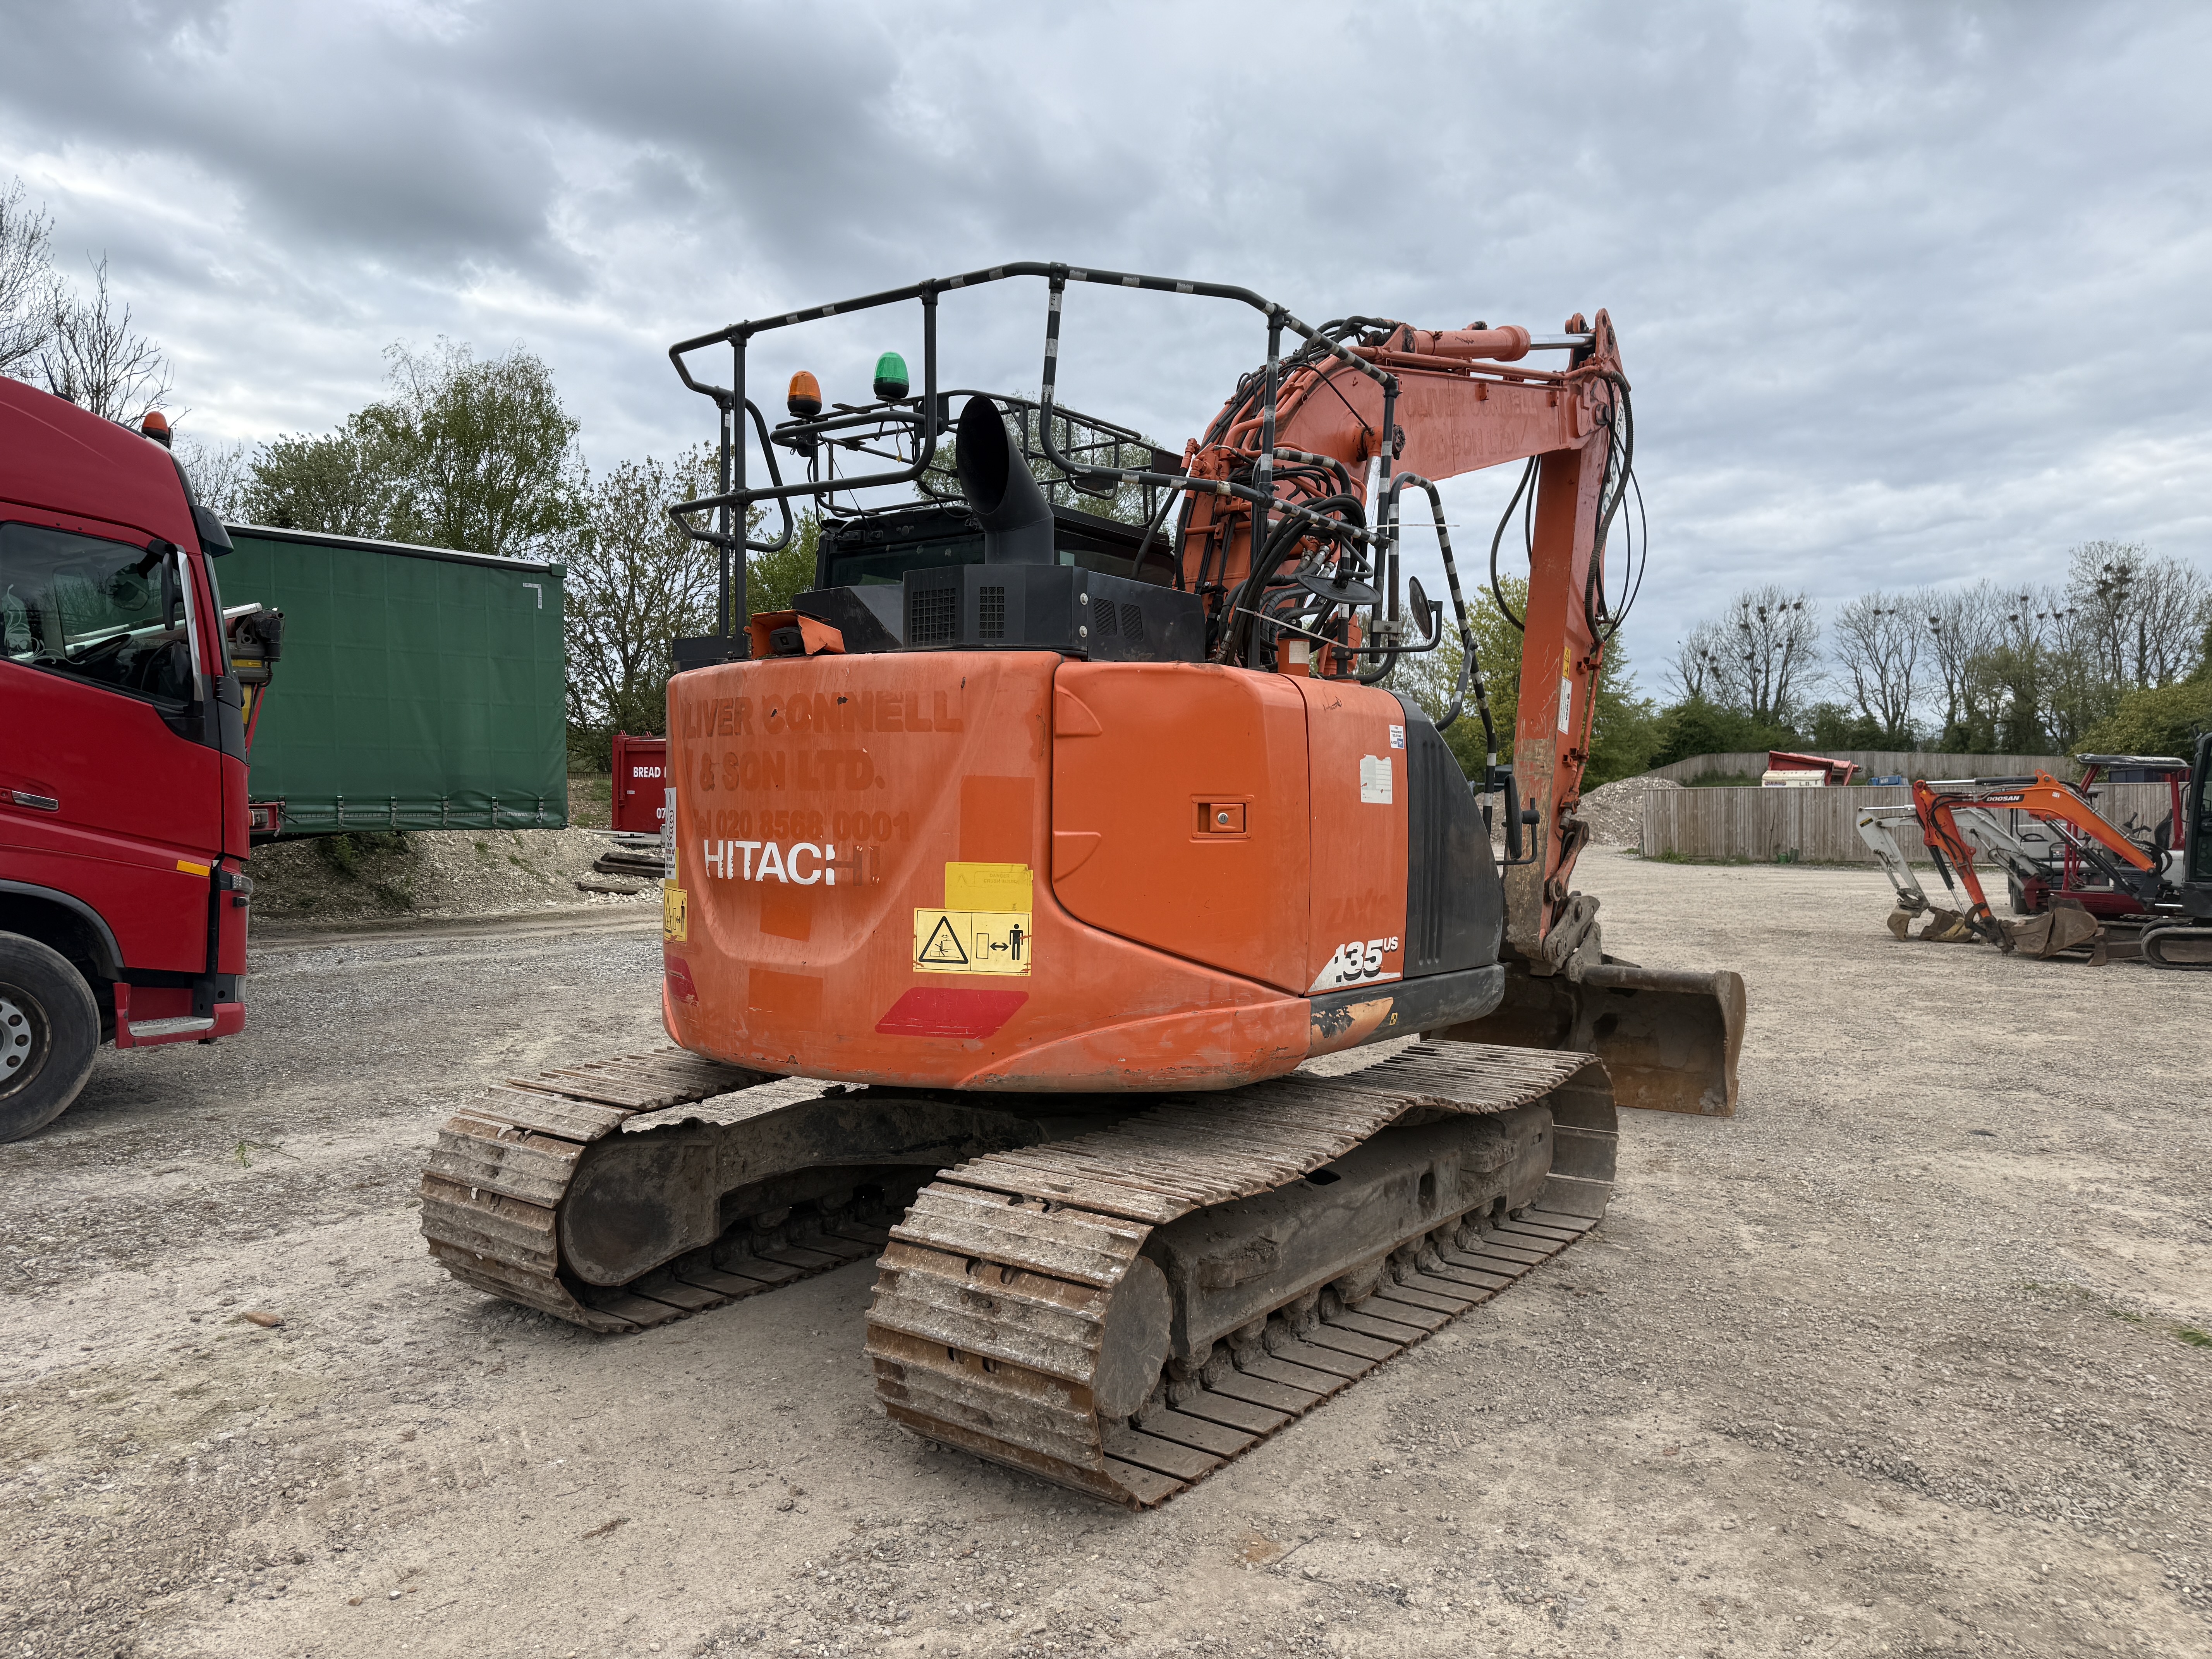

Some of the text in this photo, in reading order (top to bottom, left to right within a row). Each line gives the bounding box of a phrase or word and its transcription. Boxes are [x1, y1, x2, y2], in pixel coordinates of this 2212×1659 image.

[680, 690, 963, 739] LIVER CONNELL
[633, 766, 661, 778] BREAD
[700, 749, 886, 791] & SON LTD.
[716, 809, 753, 839] 020
[759, 809, 824, 840] 8568
[832, 811, 911, 842] 0001
[1383, 936, 1398, 953] US
